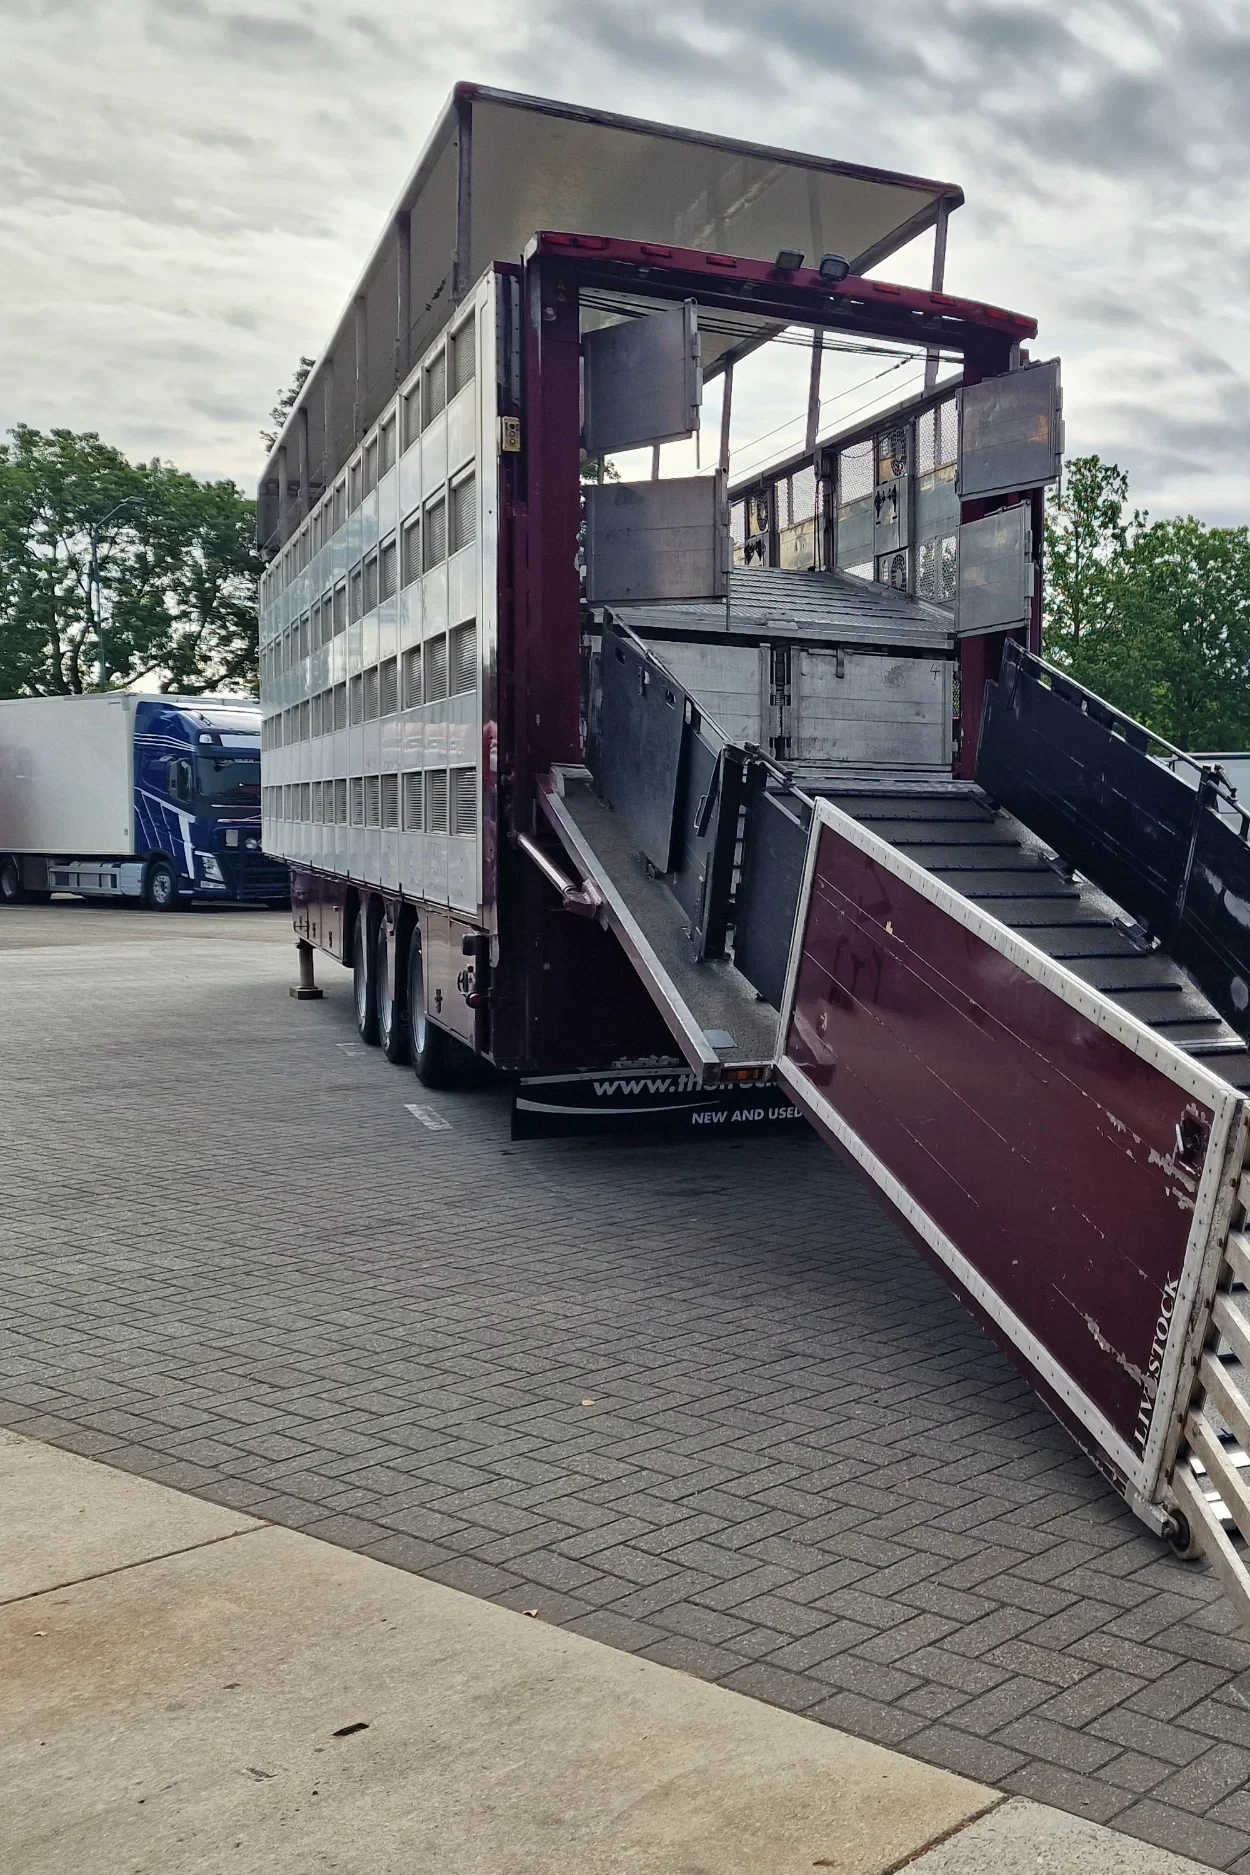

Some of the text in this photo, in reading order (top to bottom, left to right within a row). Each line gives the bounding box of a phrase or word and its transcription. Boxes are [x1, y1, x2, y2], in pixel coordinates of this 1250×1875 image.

[691, 1106, 803, 1124] NEW AND USED
